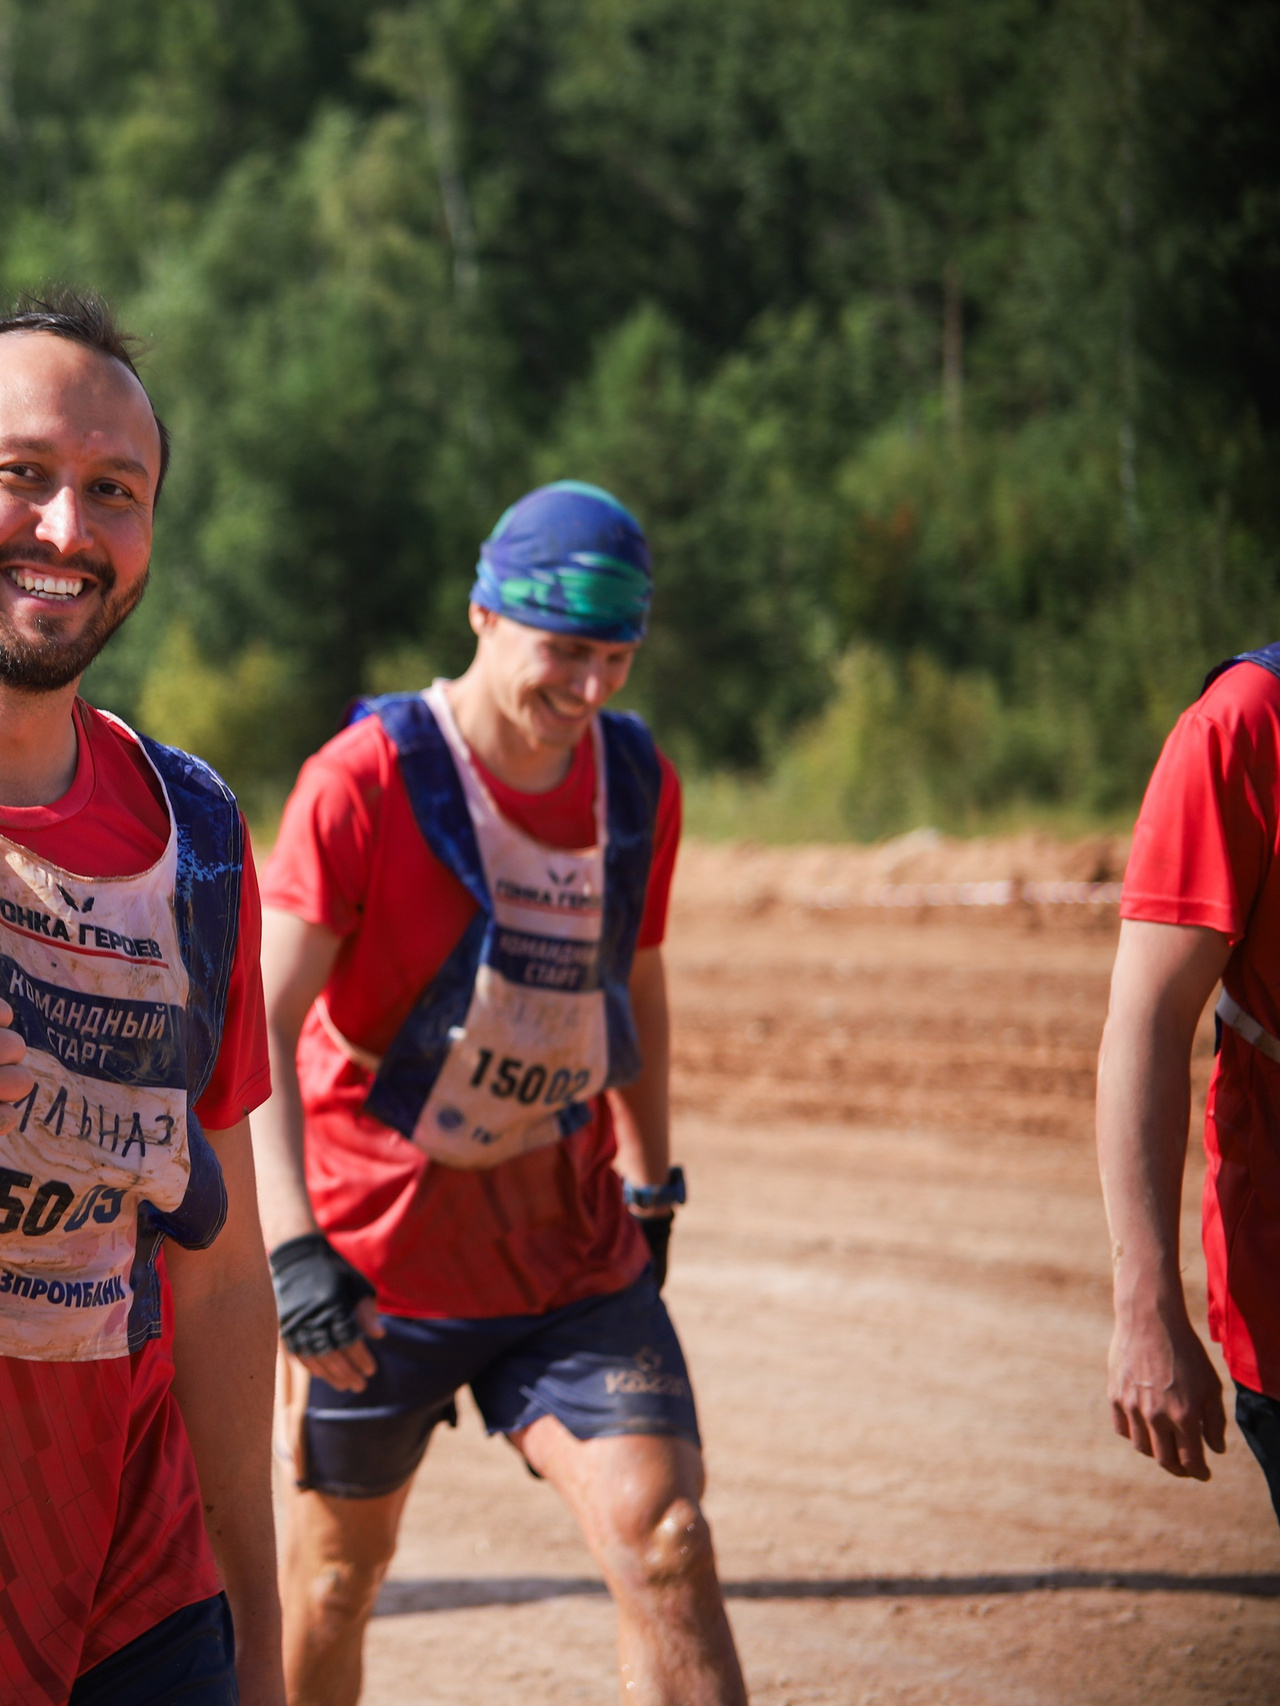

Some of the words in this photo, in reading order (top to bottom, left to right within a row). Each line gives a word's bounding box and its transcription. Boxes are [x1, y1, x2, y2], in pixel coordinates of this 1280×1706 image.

[79, 923, 163, 960] ГЕРОЕВ
[8, 967, 168, 1043] КОМАНДНЫЙ
[47, 1029, 114, 1069] СТАРТ
[470, 1047, 590, 1105] 15002
